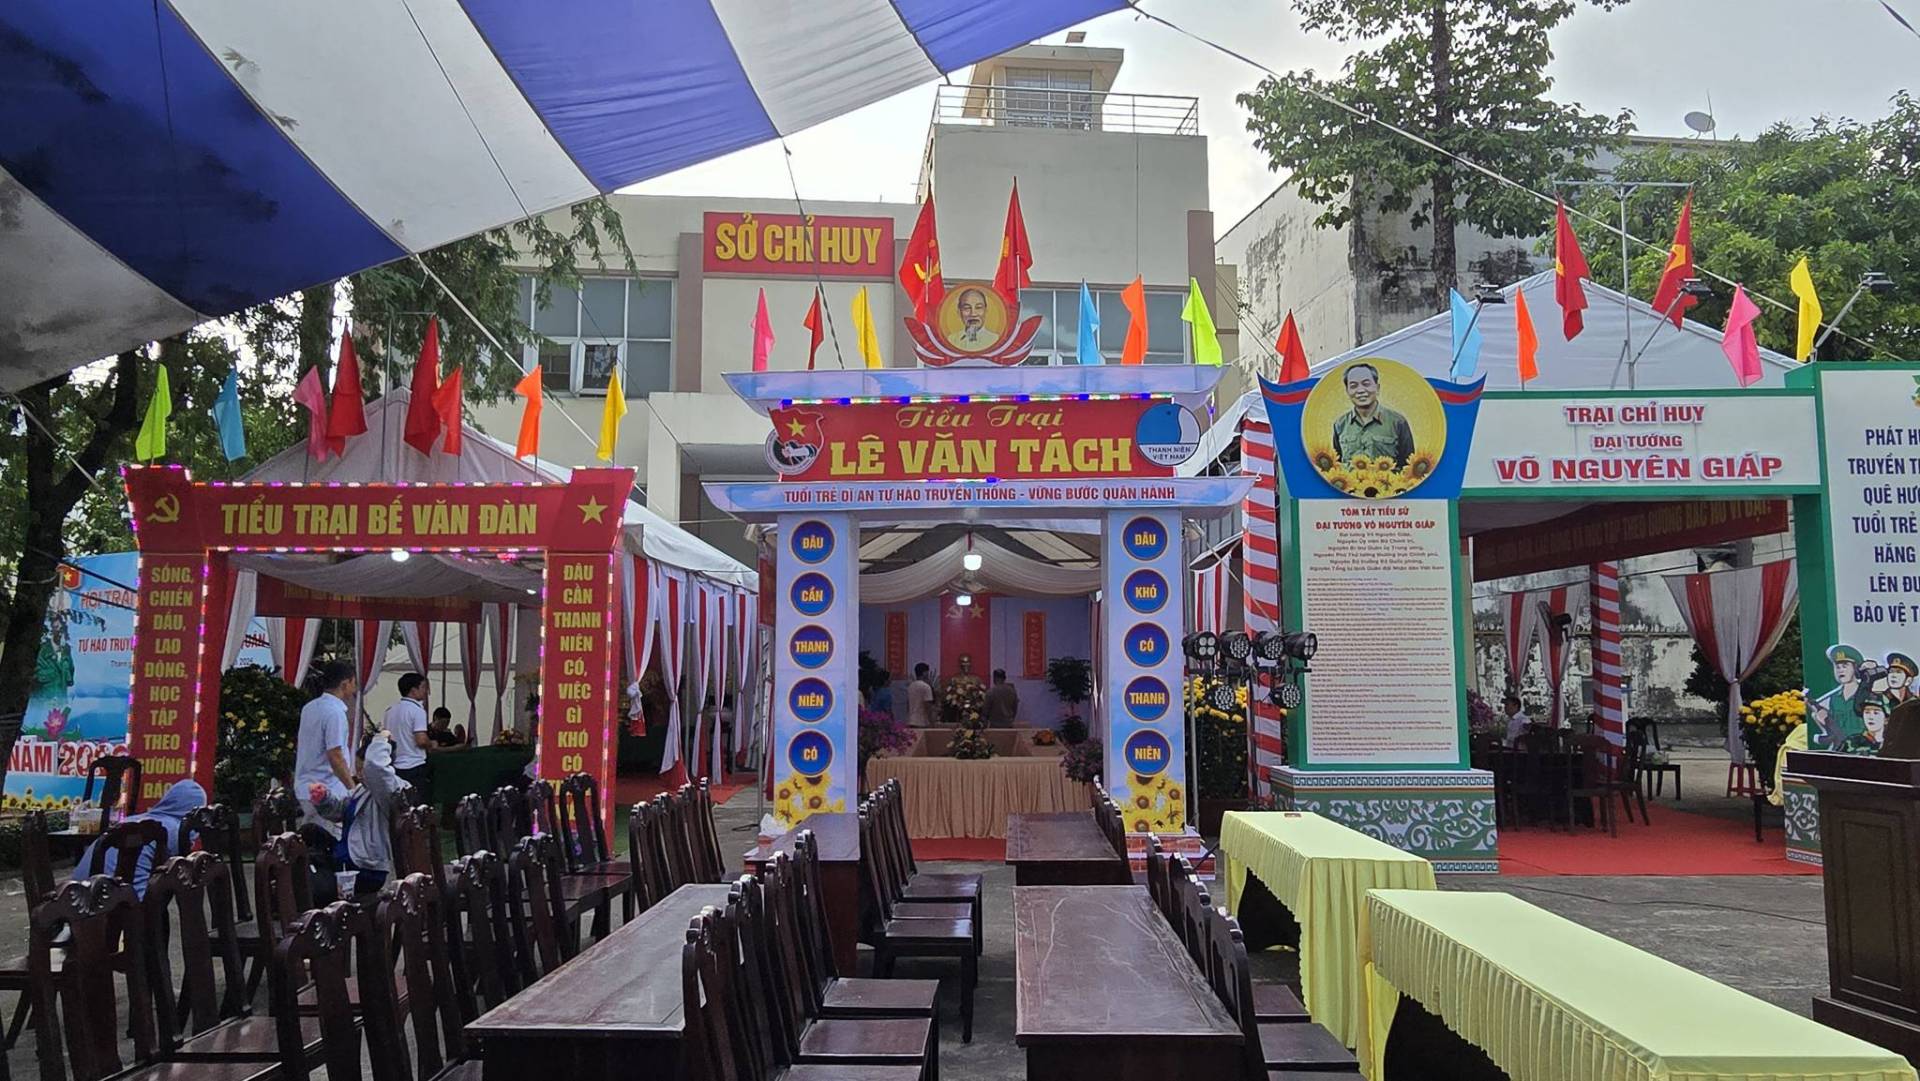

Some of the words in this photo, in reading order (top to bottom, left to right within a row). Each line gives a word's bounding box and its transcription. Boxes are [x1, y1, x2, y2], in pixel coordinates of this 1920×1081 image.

[715, 212, 758, 261] SỞ
[763, 215, 814, 262] CHỈ
[820, 227, 882, 264] HUY
[896, 405, 974, 428] Tiểu
[987, 405, 1064, 430] Trại
[1566, 407, 1614, 426] TRẠI
[1621, 401, 1656, 422] CHỈ
[1663, 406, 1705, 422] HUY
[1594, 436, 1622, 450] ĐẠI
[1627, 433, 1682, 448] TƯỚNG
[1865, 425, 1903, 445] PHÁT
[1908, 428, 1920, 445] H
[830, 434, 885, 475] LÊ
[898, 432, 997, 474] VĂN
[1010, 431, 1132, 473] TÁCH
[1497, 455, 1540, 480] VÕ
[1552, 454, 1691, 480] NGUYÊN
[1702, 453, 1783, 478] GIÁP
[784, 486, 811, 502] TUỔI
[816, 486, 837, 502] TRẺ
[857, 489, 874, 502] AN
[878, 487, 894, 504] TỰ
[896, 486, 921, 501] HÀO
[925, 484, 971, 501] TRUYỀN
[976, 485, 1016, 501] THỐNG
[1028, 485, 1062, 500] VỮNG
[1066, 484, 1099, 500] BƯỚC
[1103, 485, 1137, 500] QUÂN
[1141, 485, 1175, 499] HÀNH
[1863, 484, 1892, 506] QUÊ
[1897, 485, 1920, 504] HƯ
[221, 494, 284, 536] TIỂU
[293, 504, 358, 541] TRẠI
[367, 494, 404, 536] BẾ
[412, 499, 469, 535] VĂN
[478, 499, 538, 535] ĐÀN
[1341, 507, 1359, 516] TÓM
[1361, 505, 1376, 516] TẮT
[1378, 505, 1396, 516] TIỂU
[1316, 521, 1331, 531] ĐẠI
[1333, 520, 1362, 529] TƯỚNG
[1364, 520, 1376, 529] VÕ
[1379, 520, 1412, 529] NGUYÊN
[1415, 519, 1436, 529] GIÁP
[1852, 510, 1886, 533] TUỔI
[1890, 511, 1918, 533] TRẺ
[801, 534, 824, 549] ĐÂU
[1134, 531, 1157, 546] ĐÂU
[1874, 542, 1916, 563] HĂNG
[151, 562, 194, 584] SỐNG,
[563, 562, 594, 581] ĐÂU
[1135, 584, 1157, 599] KHÓ
[1869, 572, 1898, 592] LÊN
[149, 585, 193, 607] CHIẾN
[563, 583, 593, 604] CẦN
[553, 611, 602, 628] THANH
[1853, 600, 1884, 623] BẢO
[1888, 602, 1907, 627] VỆ
[155, 638, 181, 655] LAO
[560, 632, 593, 652] NIÊN
[794, 641, 829, 652] THANH
[1139, 637, 1154, 652] CÓ
[144, 659, 188, 682] ĐỘNG,
[563, 656, 588, 678] CÓ,
[150, 685, 181, 705] HỌC
[558, 680, 592, 703] VIỆC
[798, 692, 824, 707] NIÊN
[1129, 692, 1165, 705] THANH
[150, 707, 178, 730] TẬP
[566, 704, 582, 724] GÌ
[143, 734, 180, 751] THEO
[557, 728, 589, 748] KHÓ
[7, 738, 52, 773] NĂM
[561, 753, 583, 772] CÓ
[803, 746, 818, 761] CÓ
[1134, 745, 1161, 761] NIÊN
